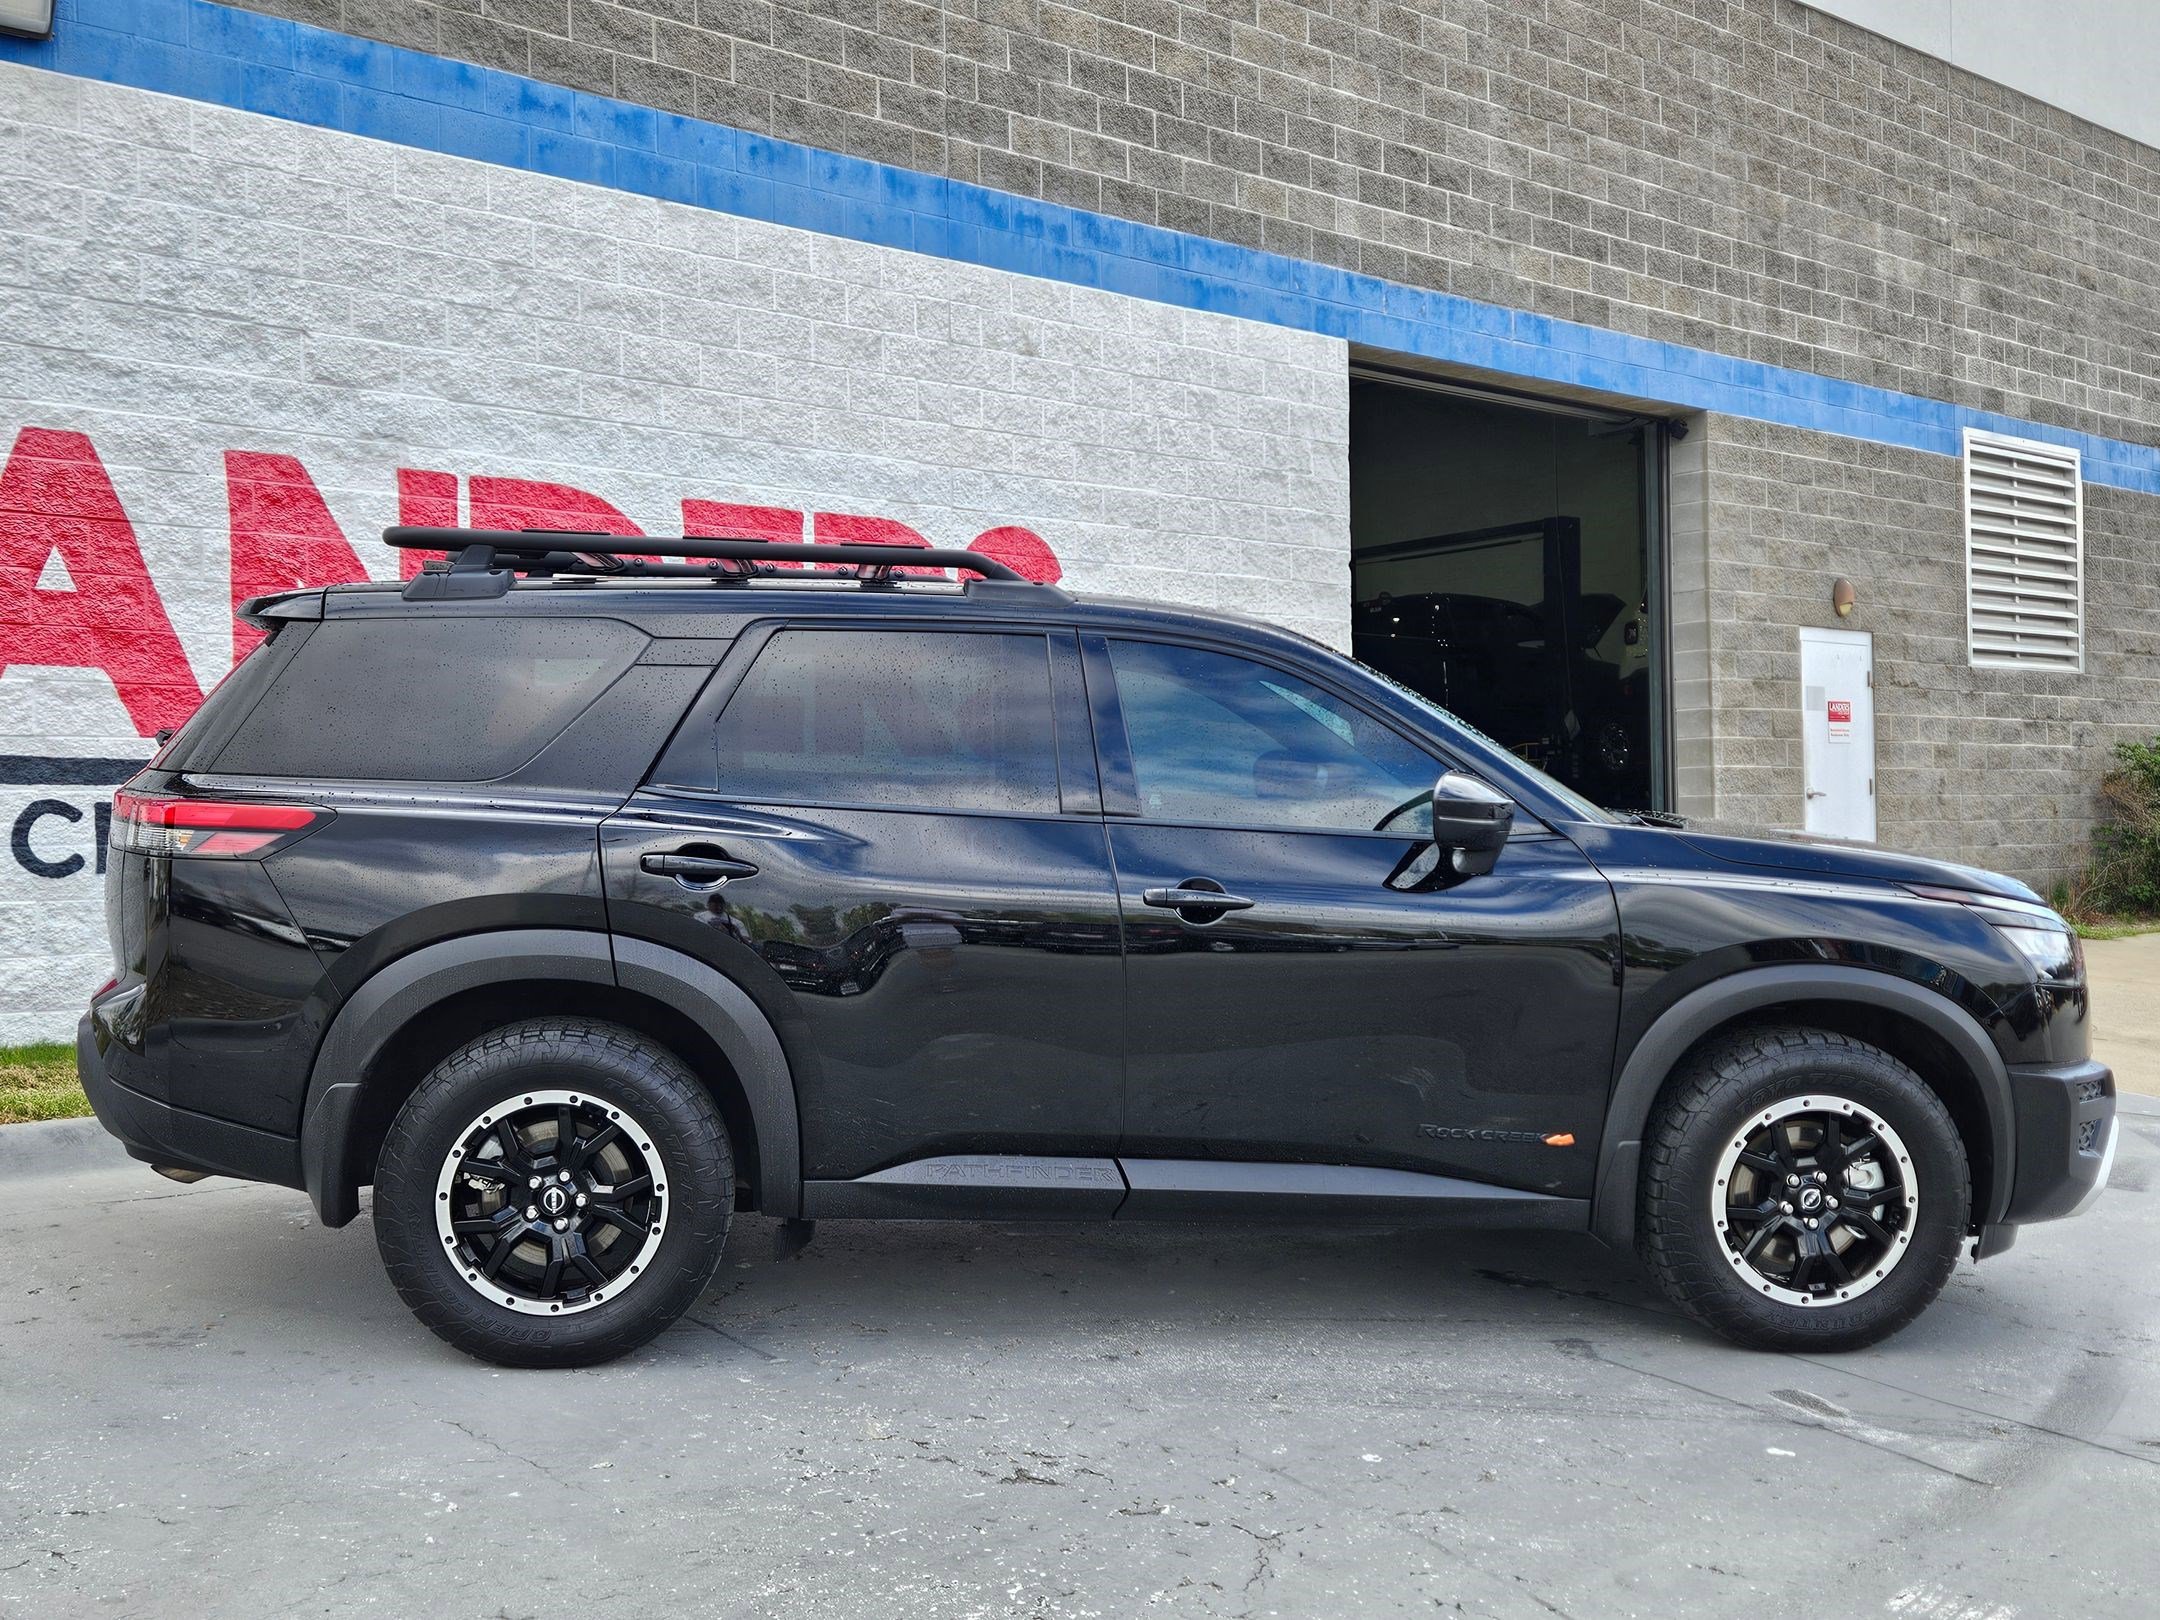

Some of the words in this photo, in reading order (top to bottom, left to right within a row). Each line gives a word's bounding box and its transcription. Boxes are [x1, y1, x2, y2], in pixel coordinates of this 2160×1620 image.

[603, 1077, 671, 1130] TOYO
[1418, 1123, 1477, 1140] ROCK
[1480, 1130, 1549, 1143] CREEK
[926, 1163, 1120, 1184] PATHFINDER
[471, 1313, 551, 1343] OPEN
